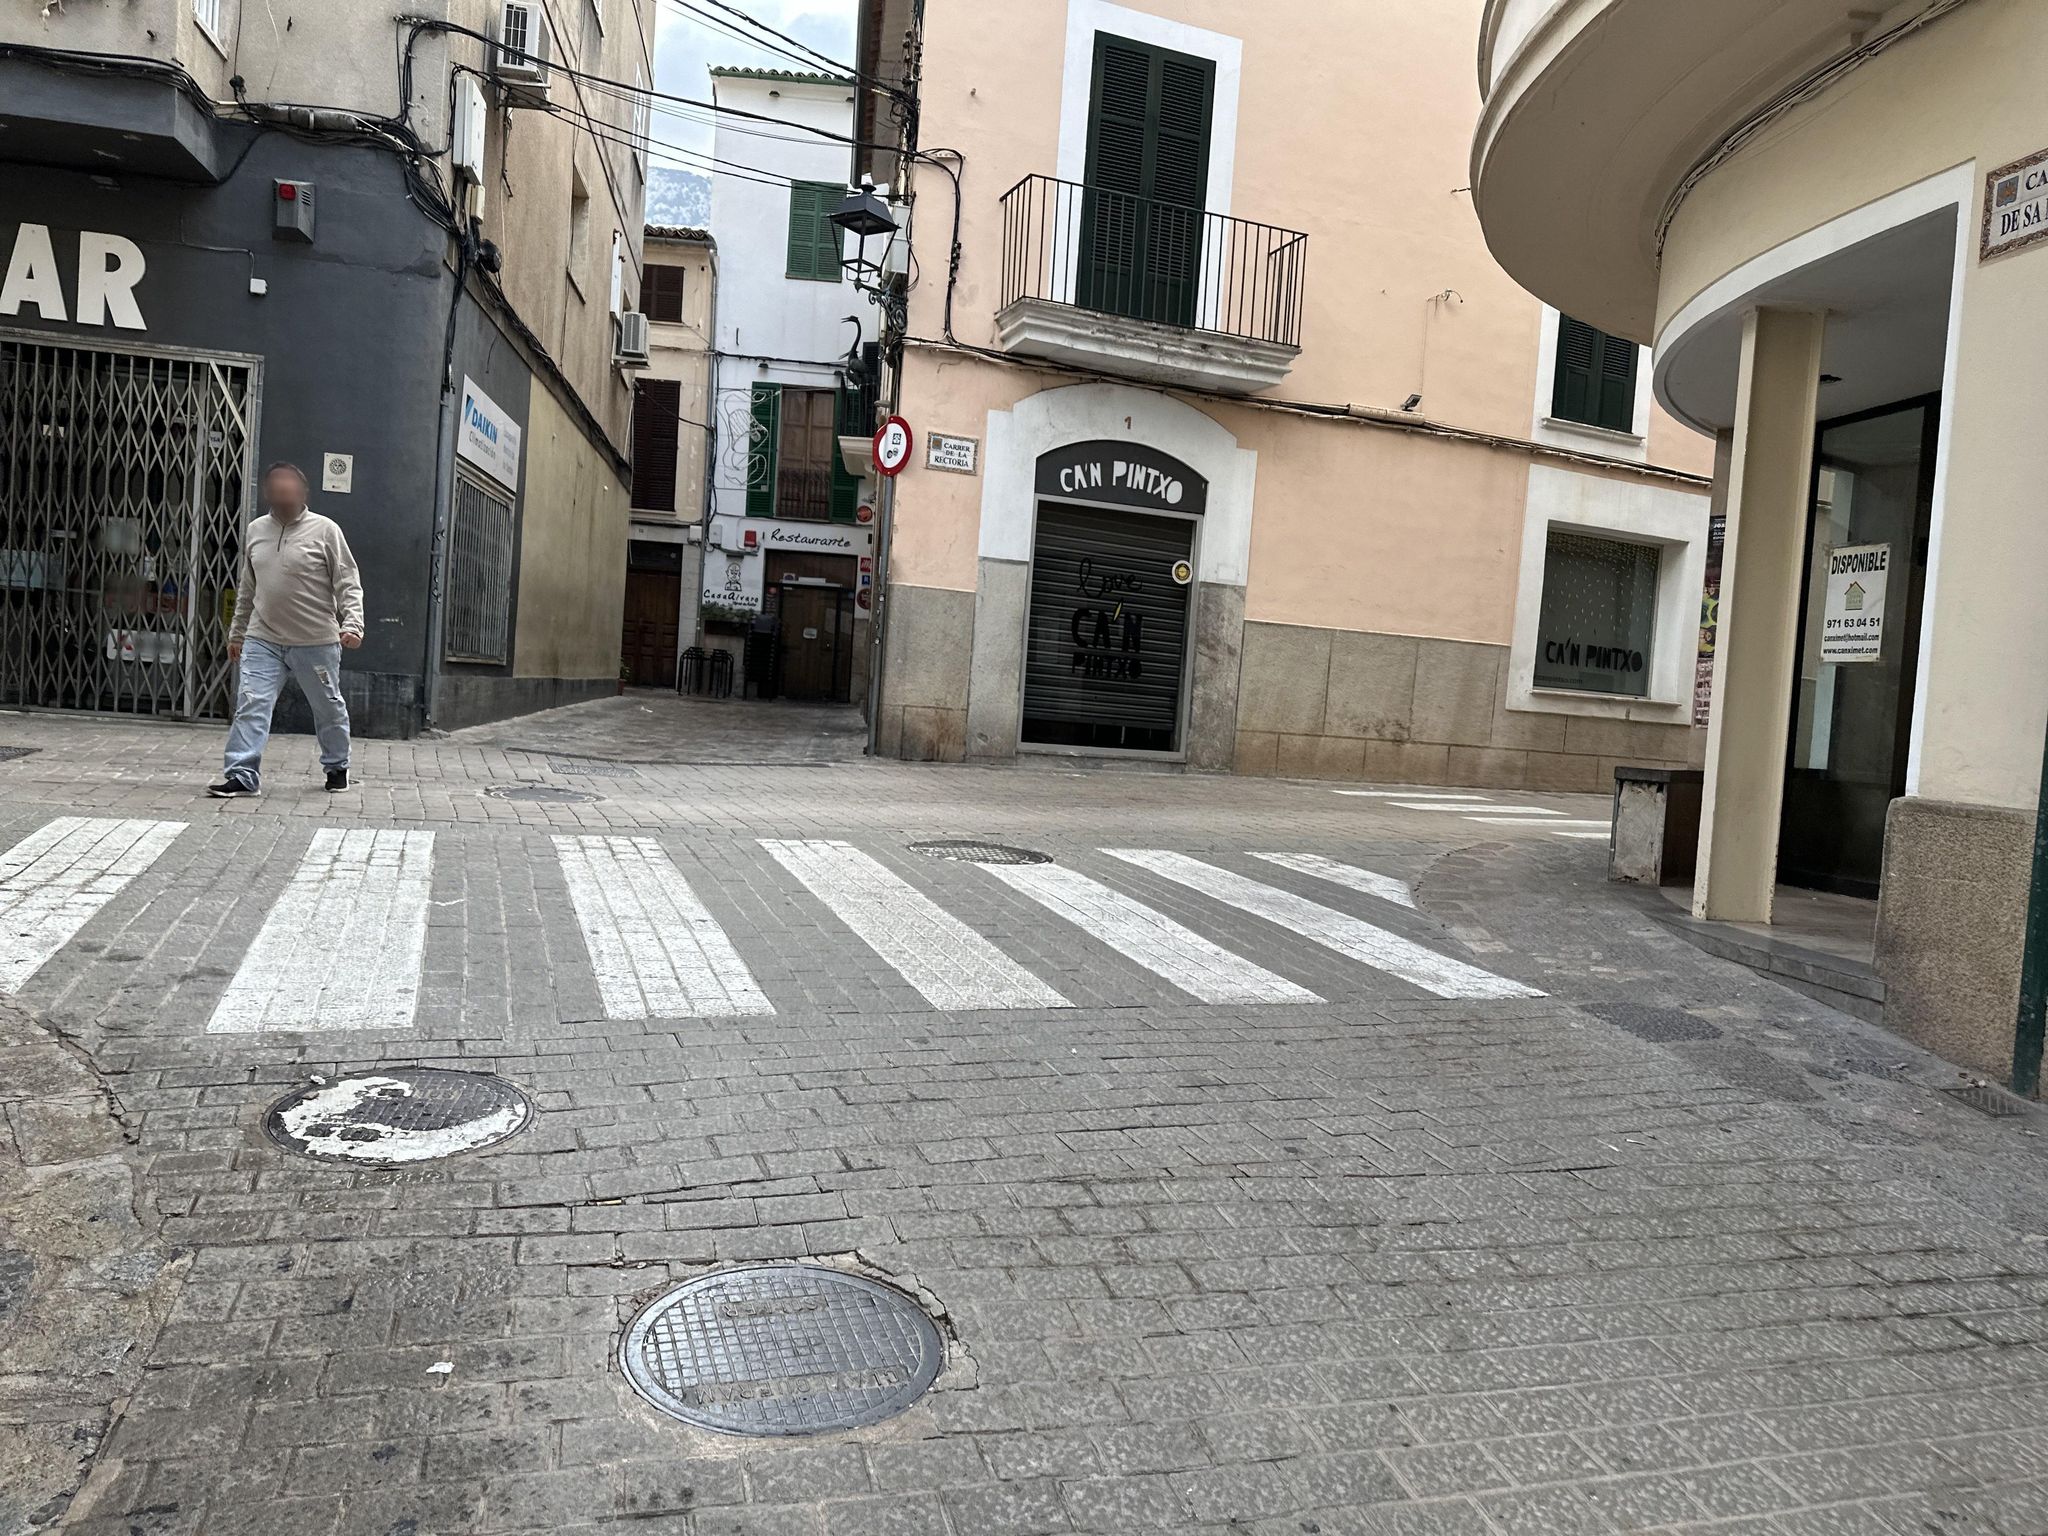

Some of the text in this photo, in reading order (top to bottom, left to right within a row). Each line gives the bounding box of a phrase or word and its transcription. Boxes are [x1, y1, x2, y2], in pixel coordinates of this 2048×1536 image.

[2000, 208, 2020, 236] DE
[2023, 201, 2041, 228] SA
[471, 407, 498, 445] DAIKIN
[1124, 416, 1132, 430] 1
[943, 442, 971, 453] CARRER
[934, 456, 969, 468] RECTORIA
[1060, 460, 1183, 504] CA'N PINTXO
[770, 528, 851, 548] Restaurante
[1831, 551, 1887, 575] DISPONIBLE
[1826, 617, 1881, 628] 971 63 04 51
[1585, 644, 1643, 672] PINTXO
[1823, 646, 1878, 655] www.canximet.com
